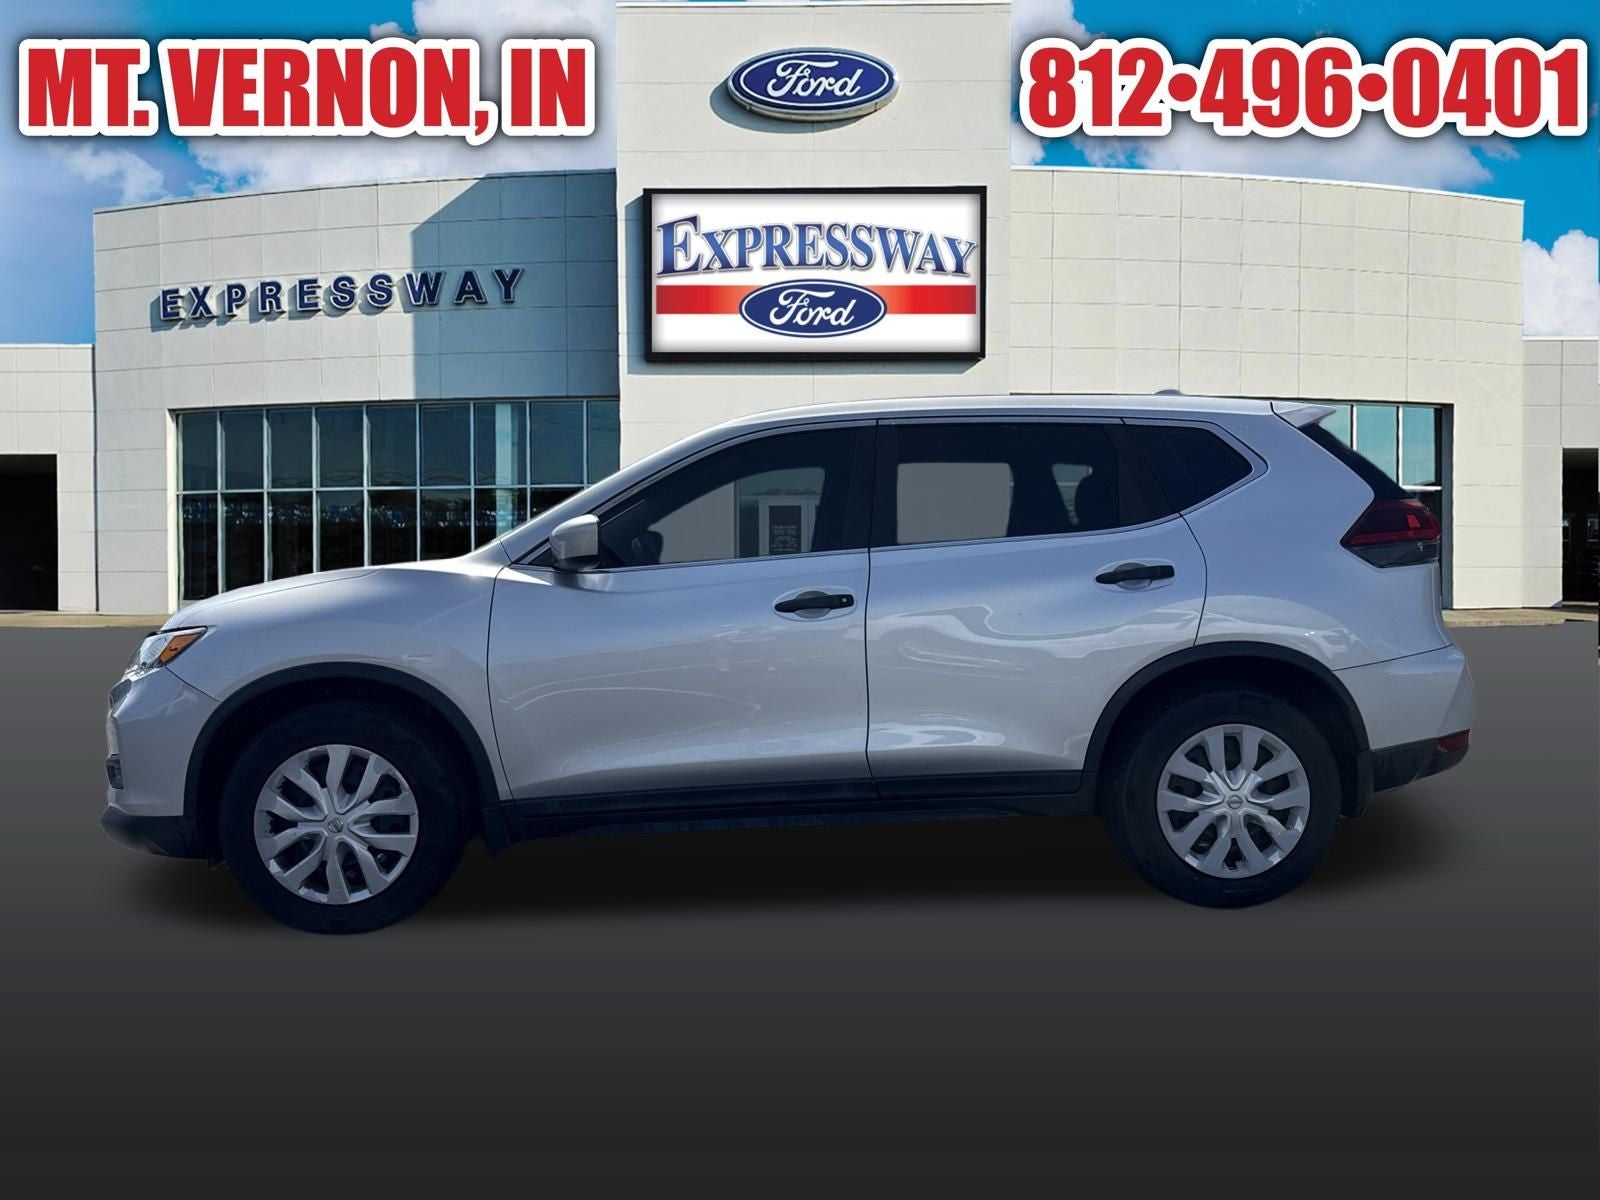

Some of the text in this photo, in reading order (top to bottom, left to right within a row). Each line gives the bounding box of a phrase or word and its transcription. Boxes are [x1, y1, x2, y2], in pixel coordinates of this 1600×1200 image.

[766, 59, 864, 98] Ford
[656, 214, 977, 277] EXPRESSWAY
[160, 267, 525, 322] EXPRESSWAY
[768, 287, 858, 327] Ford
